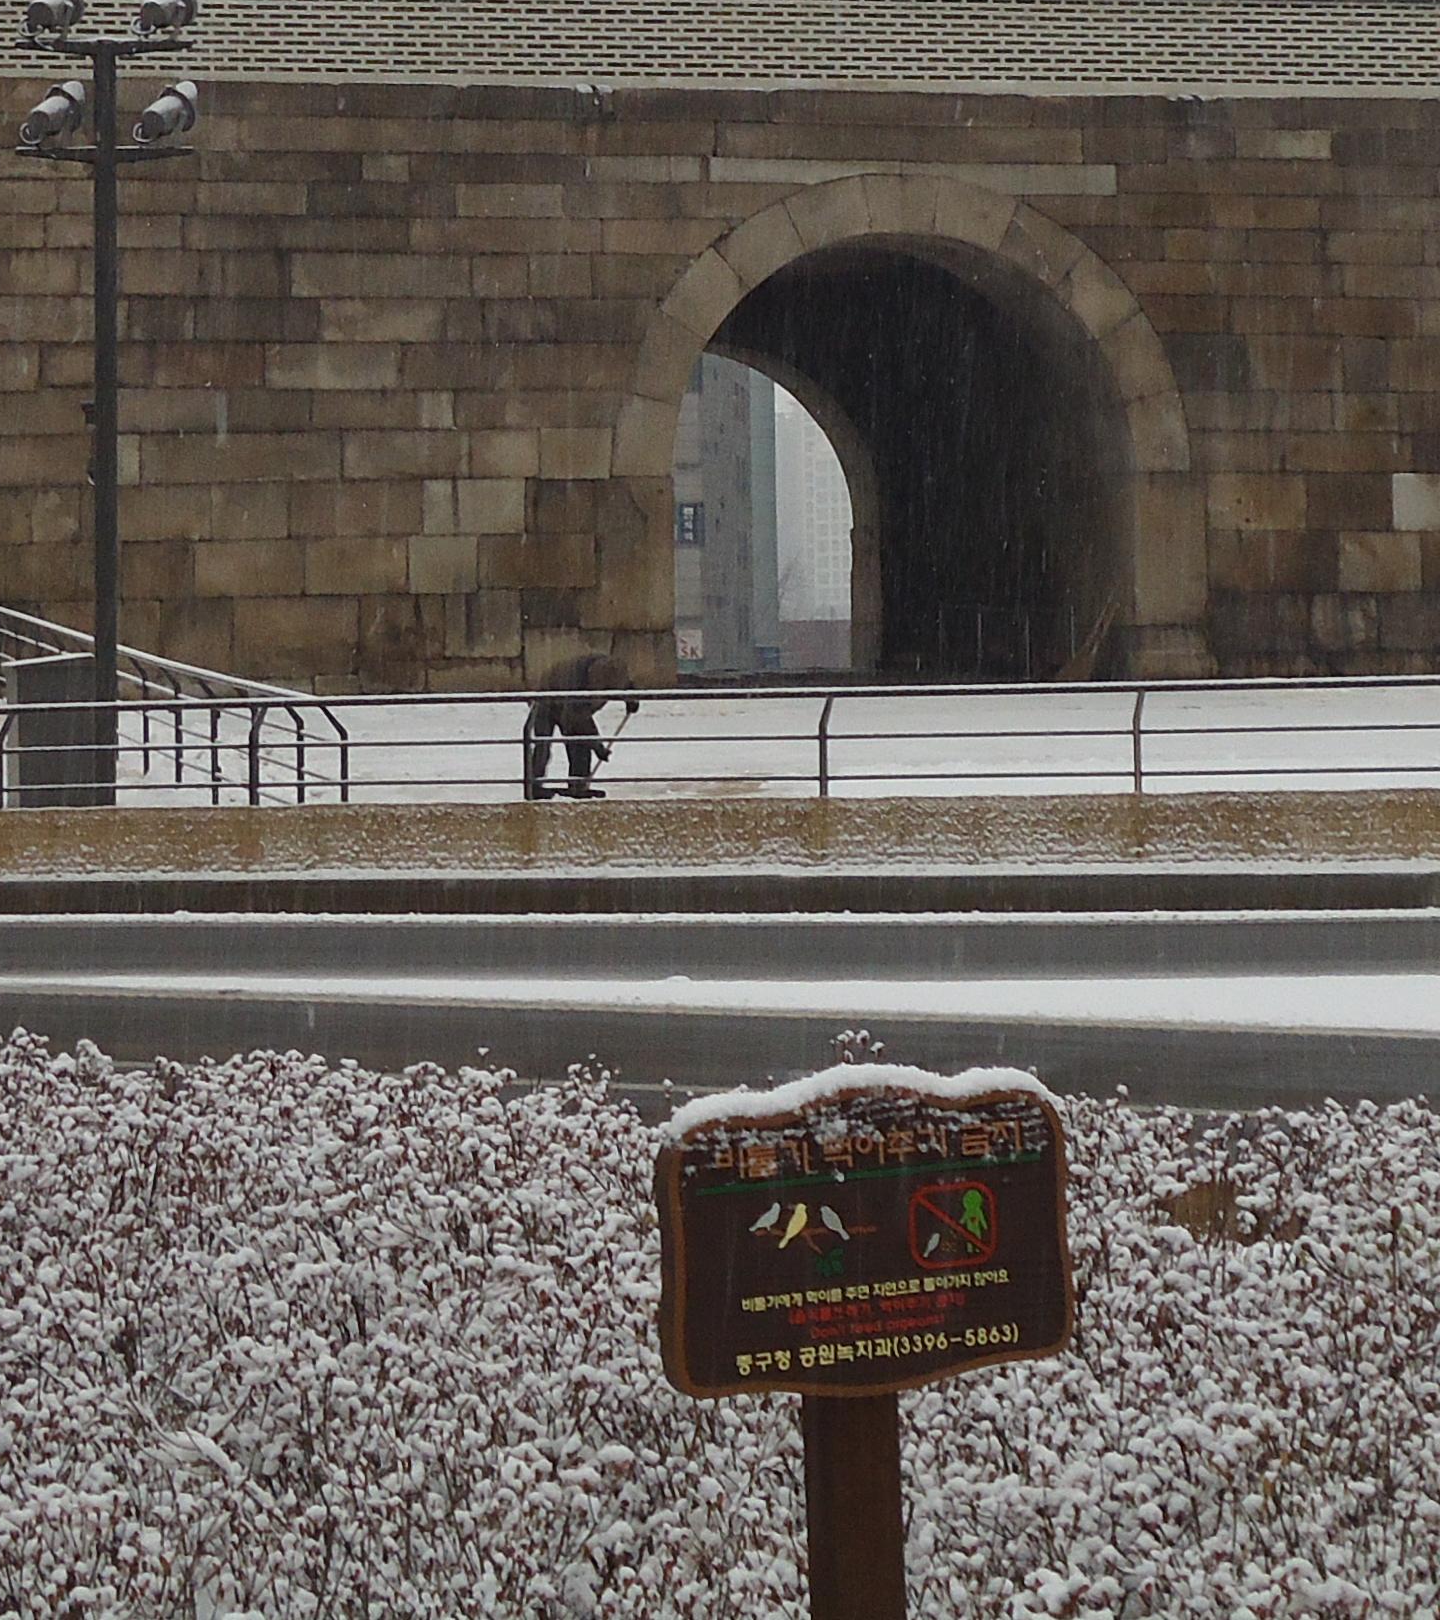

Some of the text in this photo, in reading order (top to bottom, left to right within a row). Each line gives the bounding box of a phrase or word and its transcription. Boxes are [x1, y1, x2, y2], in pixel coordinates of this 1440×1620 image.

[961, 1119, 1023, 1157] 금지
[741, 1292, 803, 1312] 비둘기에게
[736, 1350, 792, 1376] 중구청
